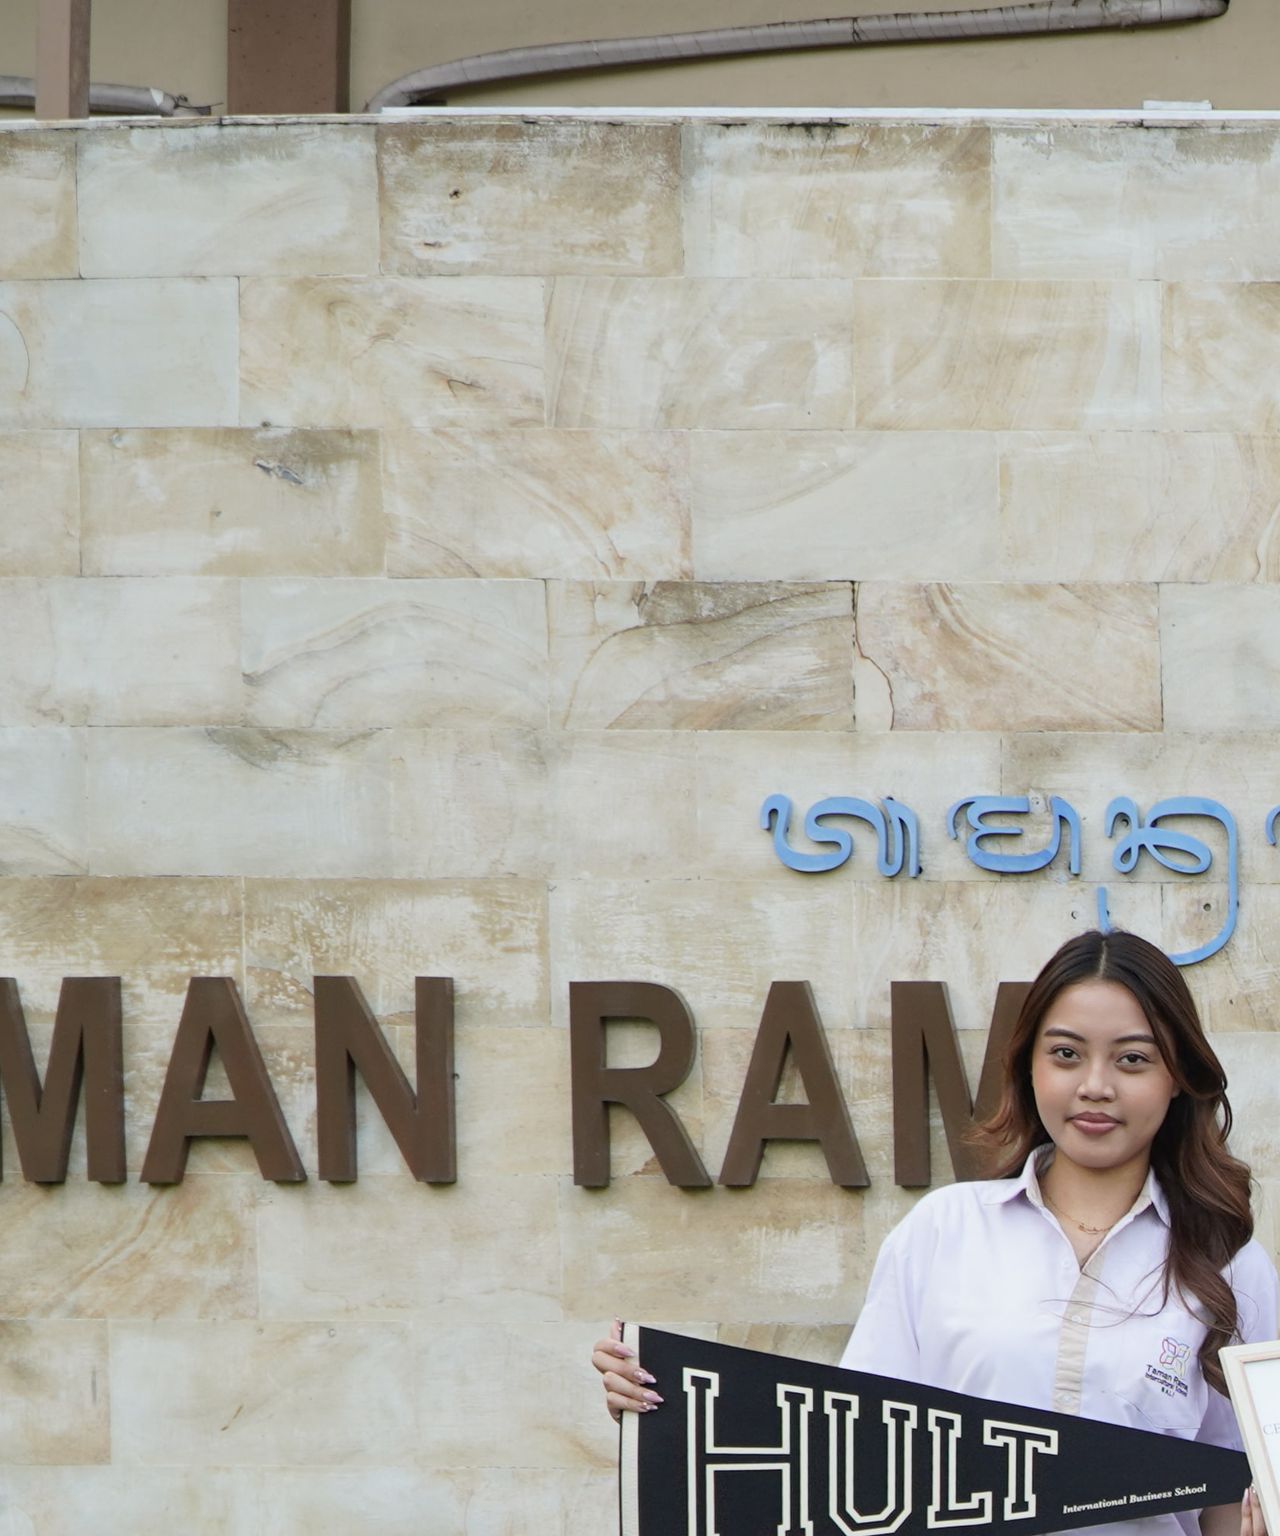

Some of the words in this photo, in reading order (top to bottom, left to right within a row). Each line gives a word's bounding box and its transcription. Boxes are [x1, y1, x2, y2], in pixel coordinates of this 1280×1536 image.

[568, 980, 1038, 1187] RAM
[1062, 1496, 1127, 1514] International
[1129, 1489, 1172, 1504] Business
[1174, 1483, 1207, 1496] School
